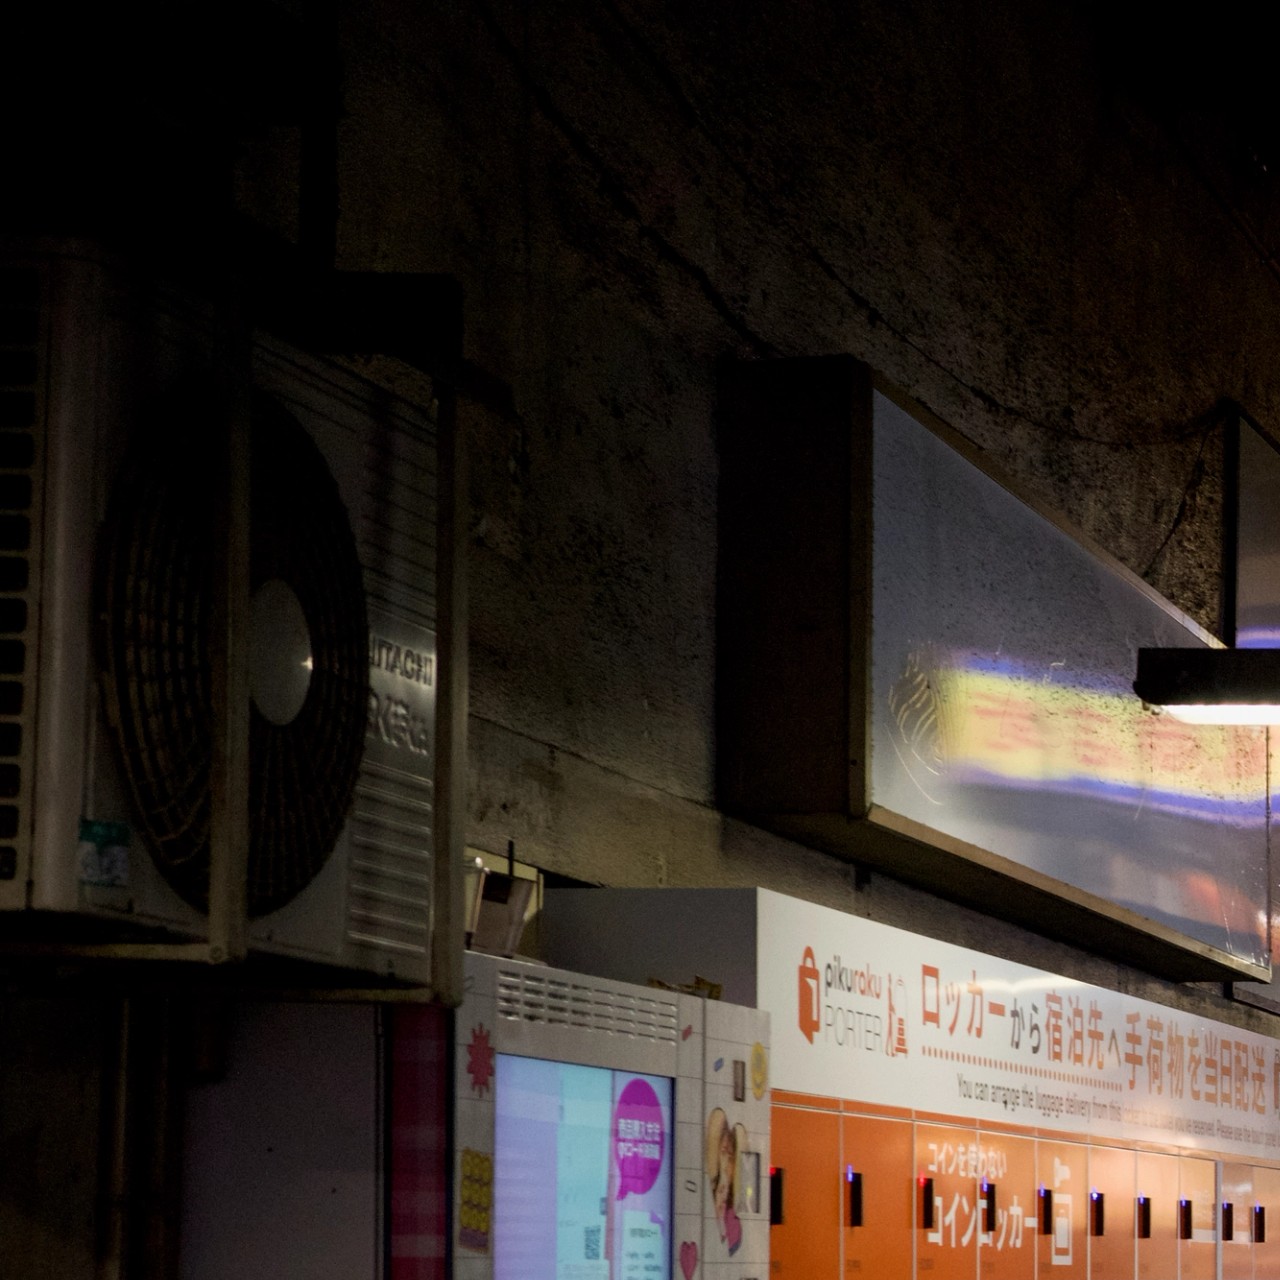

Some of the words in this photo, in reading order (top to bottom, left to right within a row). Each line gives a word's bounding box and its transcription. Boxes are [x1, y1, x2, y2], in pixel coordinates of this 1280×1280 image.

[824, 954, 883, 999] pikuraku
[824, 1004, 883, 1052] PORTER
[920, 963, 1267, 1115] ロッカーから宿泊先へ手荷物を当日配送
[957, 1072, 973, 1099] You
[974, 1081, 990, 1101] can
[927, 1142, 1008, 1179] コインを使わない
[927, 1192, 1038, 1251] コインロッカー
